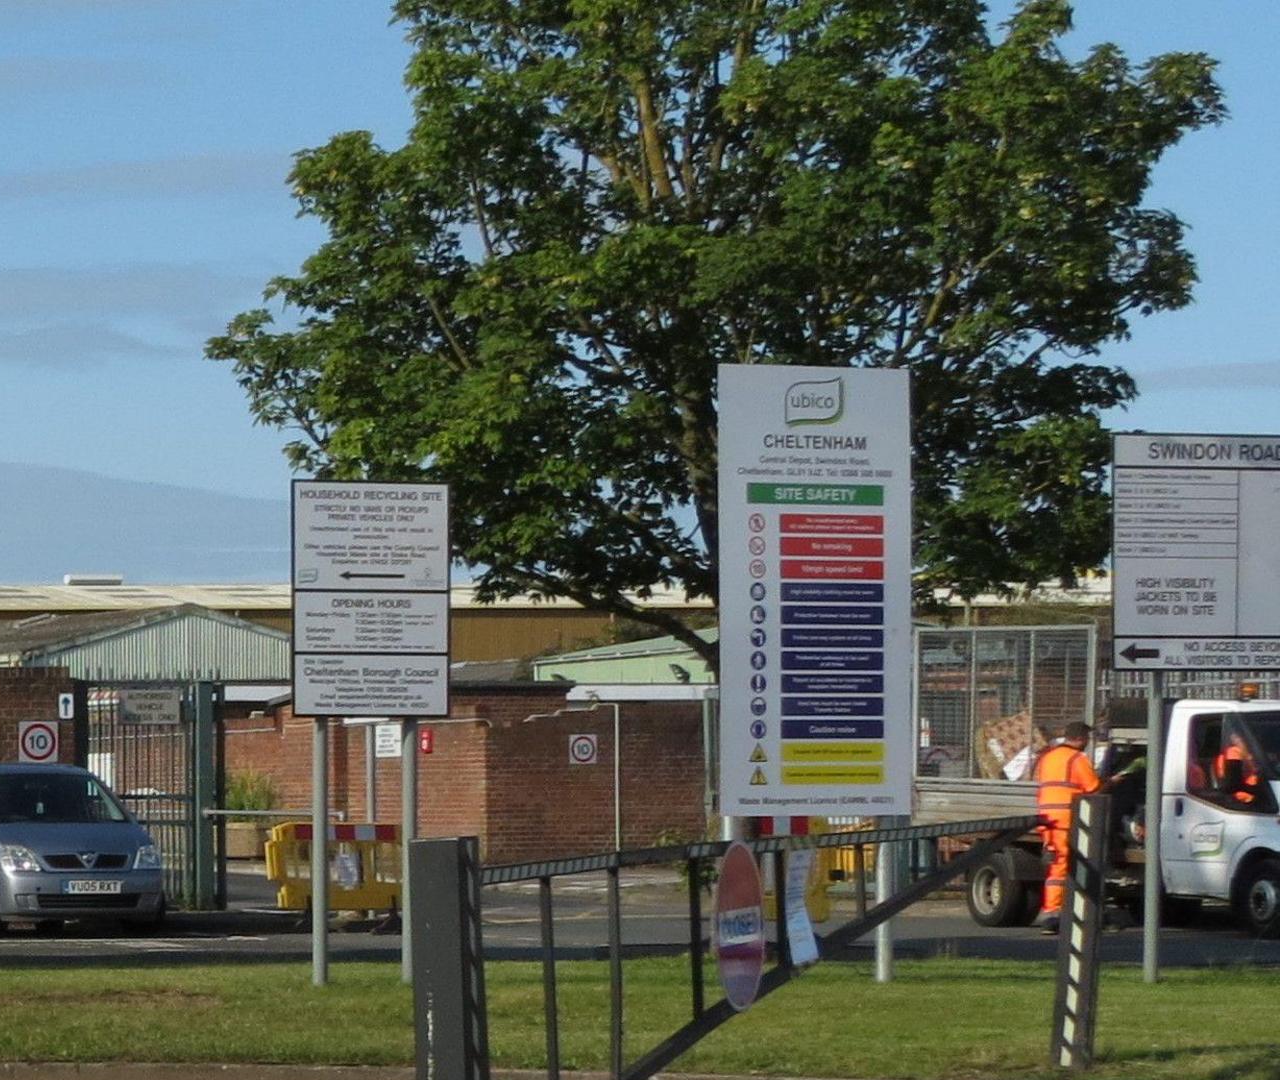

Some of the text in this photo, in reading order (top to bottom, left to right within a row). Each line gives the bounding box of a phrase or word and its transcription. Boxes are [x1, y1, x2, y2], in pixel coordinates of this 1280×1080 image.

[791, 394, 834, 408] ubico
[764, 434, 867, 449] CHELTENHAM
[1149, 443, 1231, 461] SWINDON
[300, 490, 442, 501] HOUSEHOLD RECYCLING SITE
[774, 488, 856, 502] SITE SAFETY
[1135, 578, 1215, 589] HIGH VISIBILITY
[1135, 591, 1217, 602] JACKETS TO BE
[331, 599, 411, 608] OPENING HOURS
[1137, 604, 1215, 616] WORN ON SITE
[1184, 642, 1200, 652] NO
[1204, 642, 1245, 652] ACCESS
[1164, 655, 1184, 665] ALL
[1187, 655, 1232, 665] VISITORS
[304, 667, 439, 678] Cheltenham Borough Council
[28, 734, 47, 750] 10
[577, 744, 589, 756] 10
[71, 881, 120, 893] VU05 RXT
